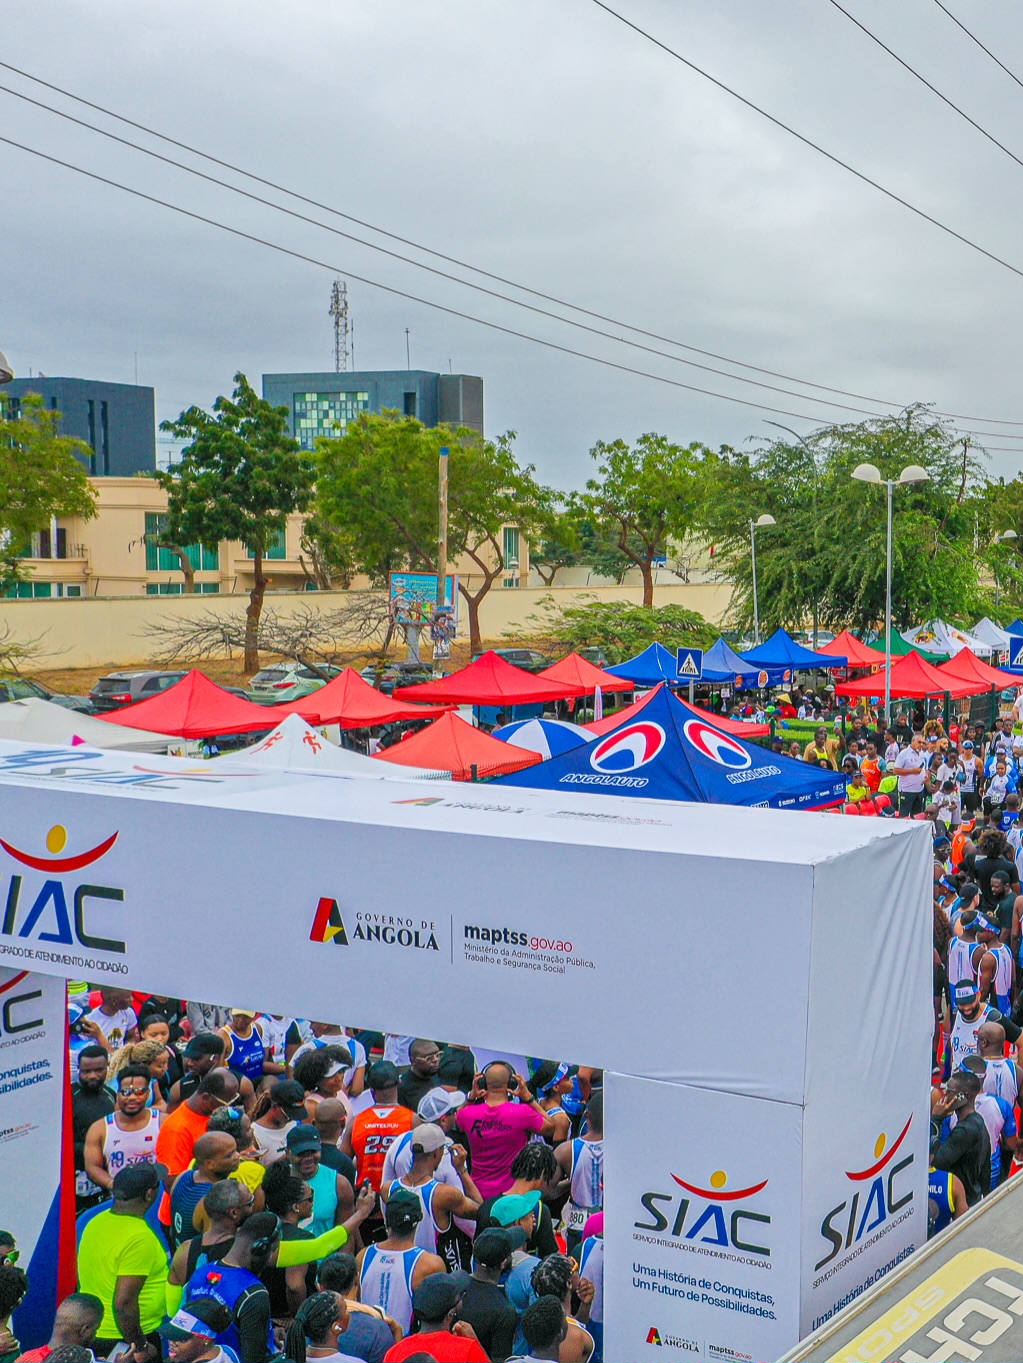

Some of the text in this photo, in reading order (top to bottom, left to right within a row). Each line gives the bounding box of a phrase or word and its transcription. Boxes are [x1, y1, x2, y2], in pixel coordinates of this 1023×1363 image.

[559, 773, 649, 788] ANGOLAUTO
[726, 765, 782, 785] ANGOLAUTO
[2, 875, 127, 954] IAC
[356, 912, 436, 931] GOVERNO DE
[353, 925, 440, 952] ANGOLA
[464, 923, 574, 953] maptss.gov.ao
[24, 950, 129, 975] DE ATENDIMENTO AO CIDADÃO
[464, 943, 596, 970] Ministério da Administração Pública,
[464, 952, 566, 974] Trabalho e Segurança Social
[634, 1192, 771, 1256] SIAC
[814, 1153, 914, 1272] SIAC
[632, 1233, 772, 1270] SERVIÇO INTEGRADO DE ATENDIMENTO AO CIDADÃO
[812, 1207, 915, 1289] SERVIÇO INTEGRADO DE ATENDIMENTO AO CIDADÃO
[632, 1263, 775, 1306] Uma História de Conquistas,
[632, 1277, 777, 1321] Um Futuro de Possibilidades.
[812, 1274, 874, 1332] Uma História de
[664, 1337, 700, 1354] ANGOLA
[709, 1342, 752, 1361] maptss.gov.ao
